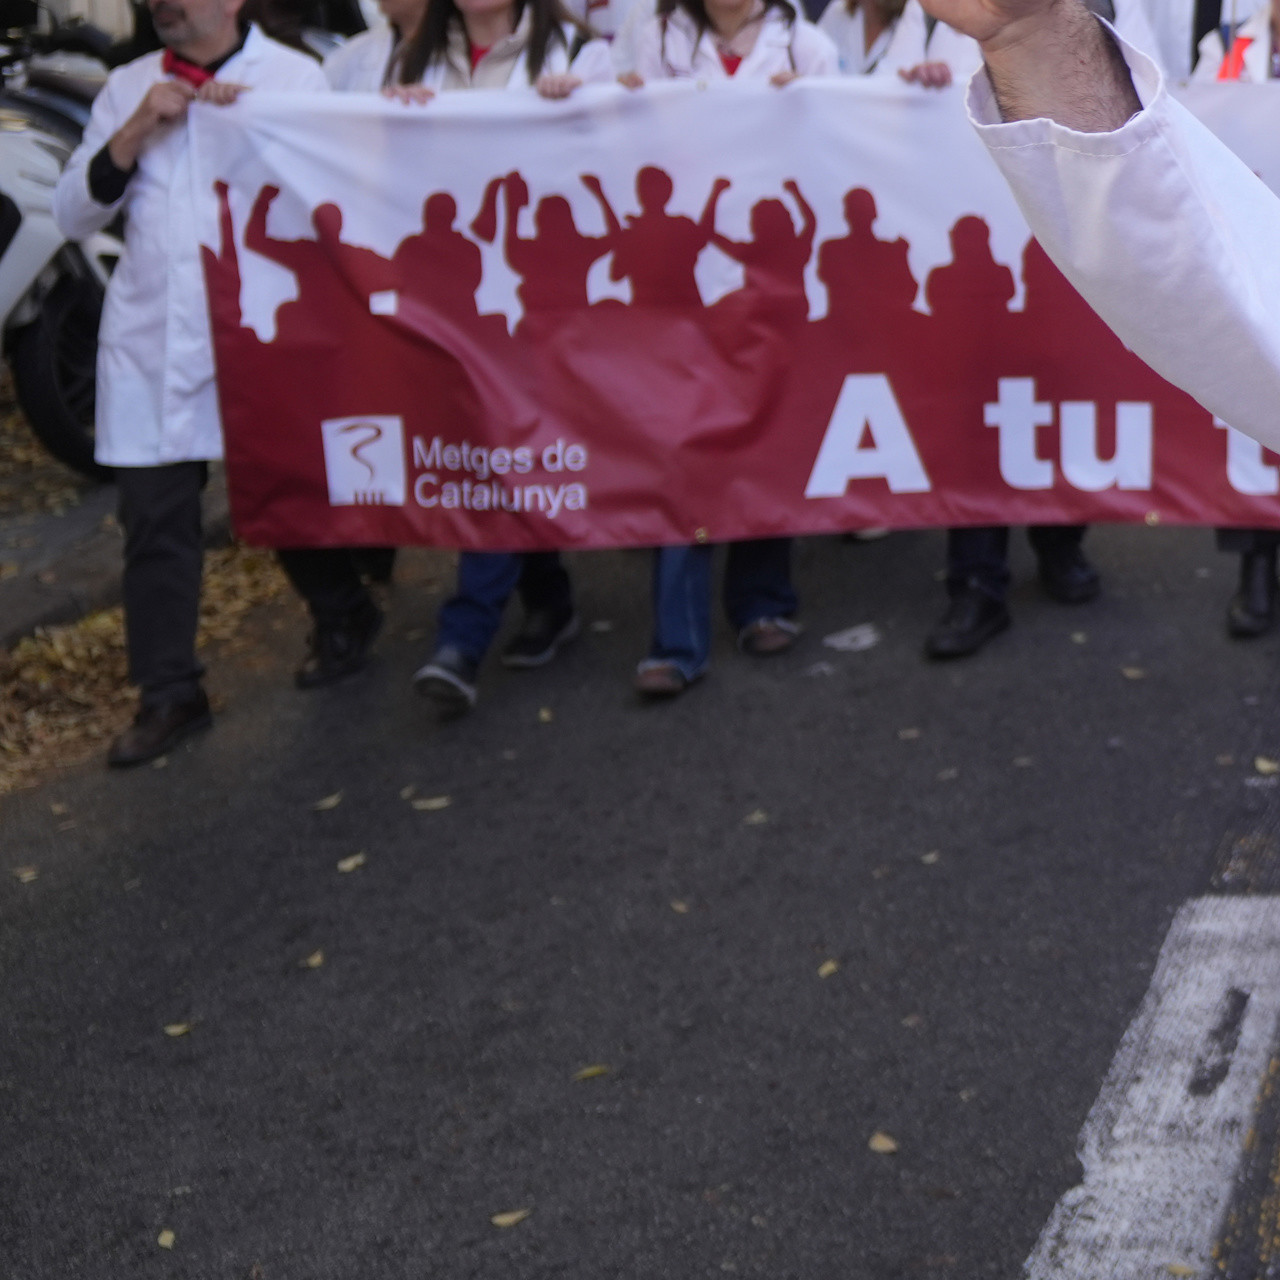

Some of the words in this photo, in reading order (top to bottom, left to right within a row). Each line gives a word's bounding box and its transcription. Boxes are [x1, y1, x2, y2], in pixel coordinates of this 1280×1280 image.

[412, 435, 535, 481] Metges
[541, 437, 588, 473] de
[804, 373, 931, 499] A
[983, 376, 1153, 493] tu
[413, 472, 588, 520] Catalunya
